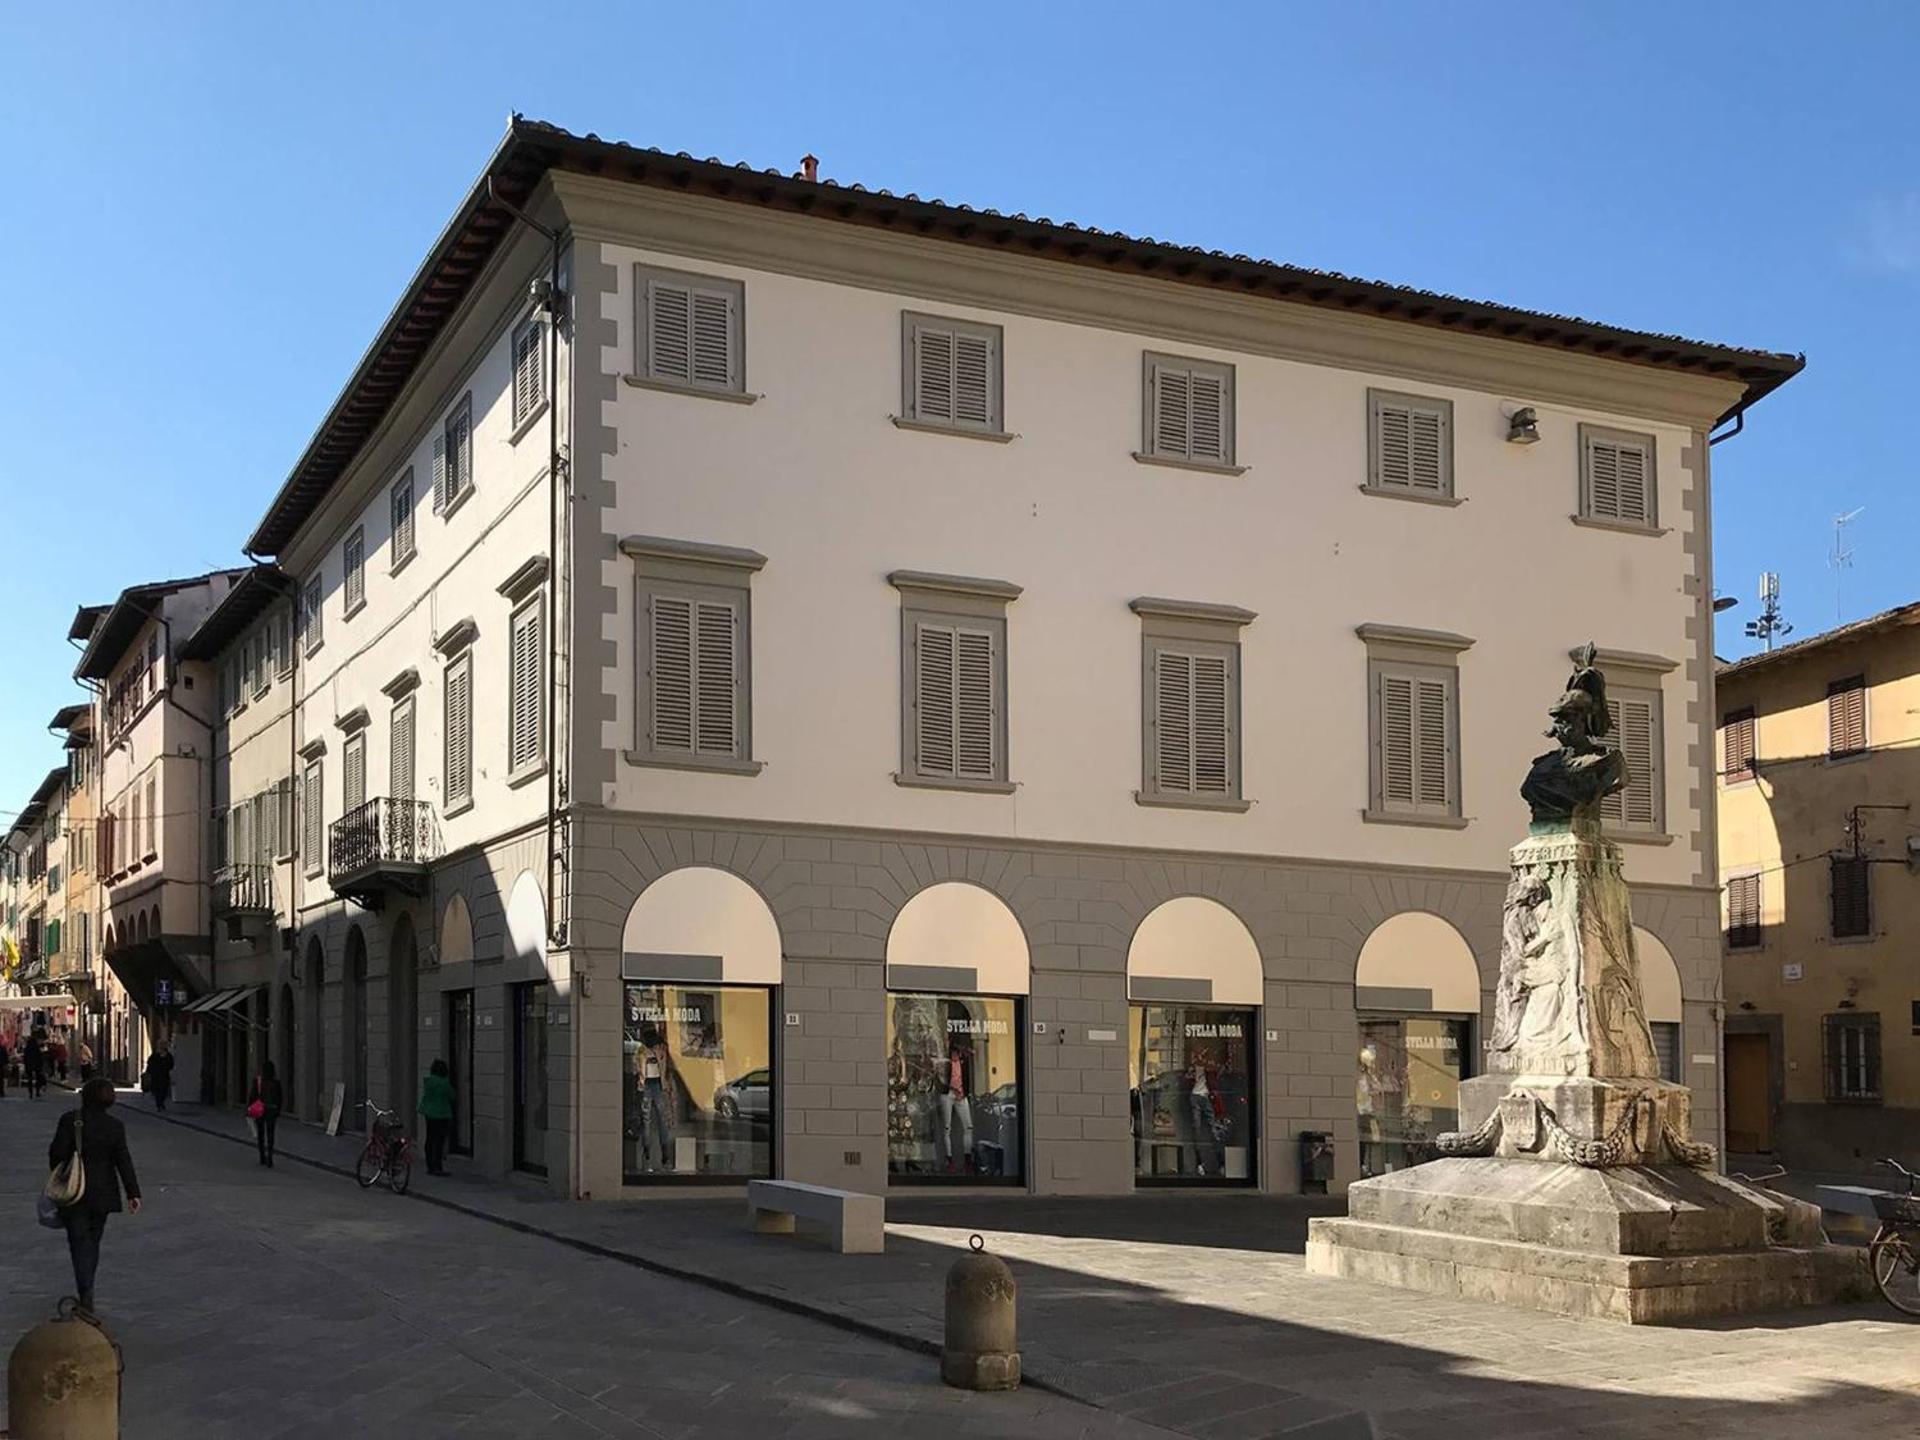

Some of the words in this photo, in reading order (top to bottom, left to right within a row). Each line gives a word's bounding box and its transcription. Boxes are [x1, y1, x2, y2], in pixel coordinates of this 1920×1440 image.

[631, 1006, 670, 1022] STELLA
[672, 1007, 701, 1022] MODA
[946, 1019, 981, 1033] STELLA
[983, 1020, 1008, 1034] MODA
[1185, 1024, 1217, 1037] STELLA
[1219, 1024, 1243, 1037] MODA
[1405, 1036, 1434, 1048] STELLA
[1436, 1037, 1458, 1049] MODA
